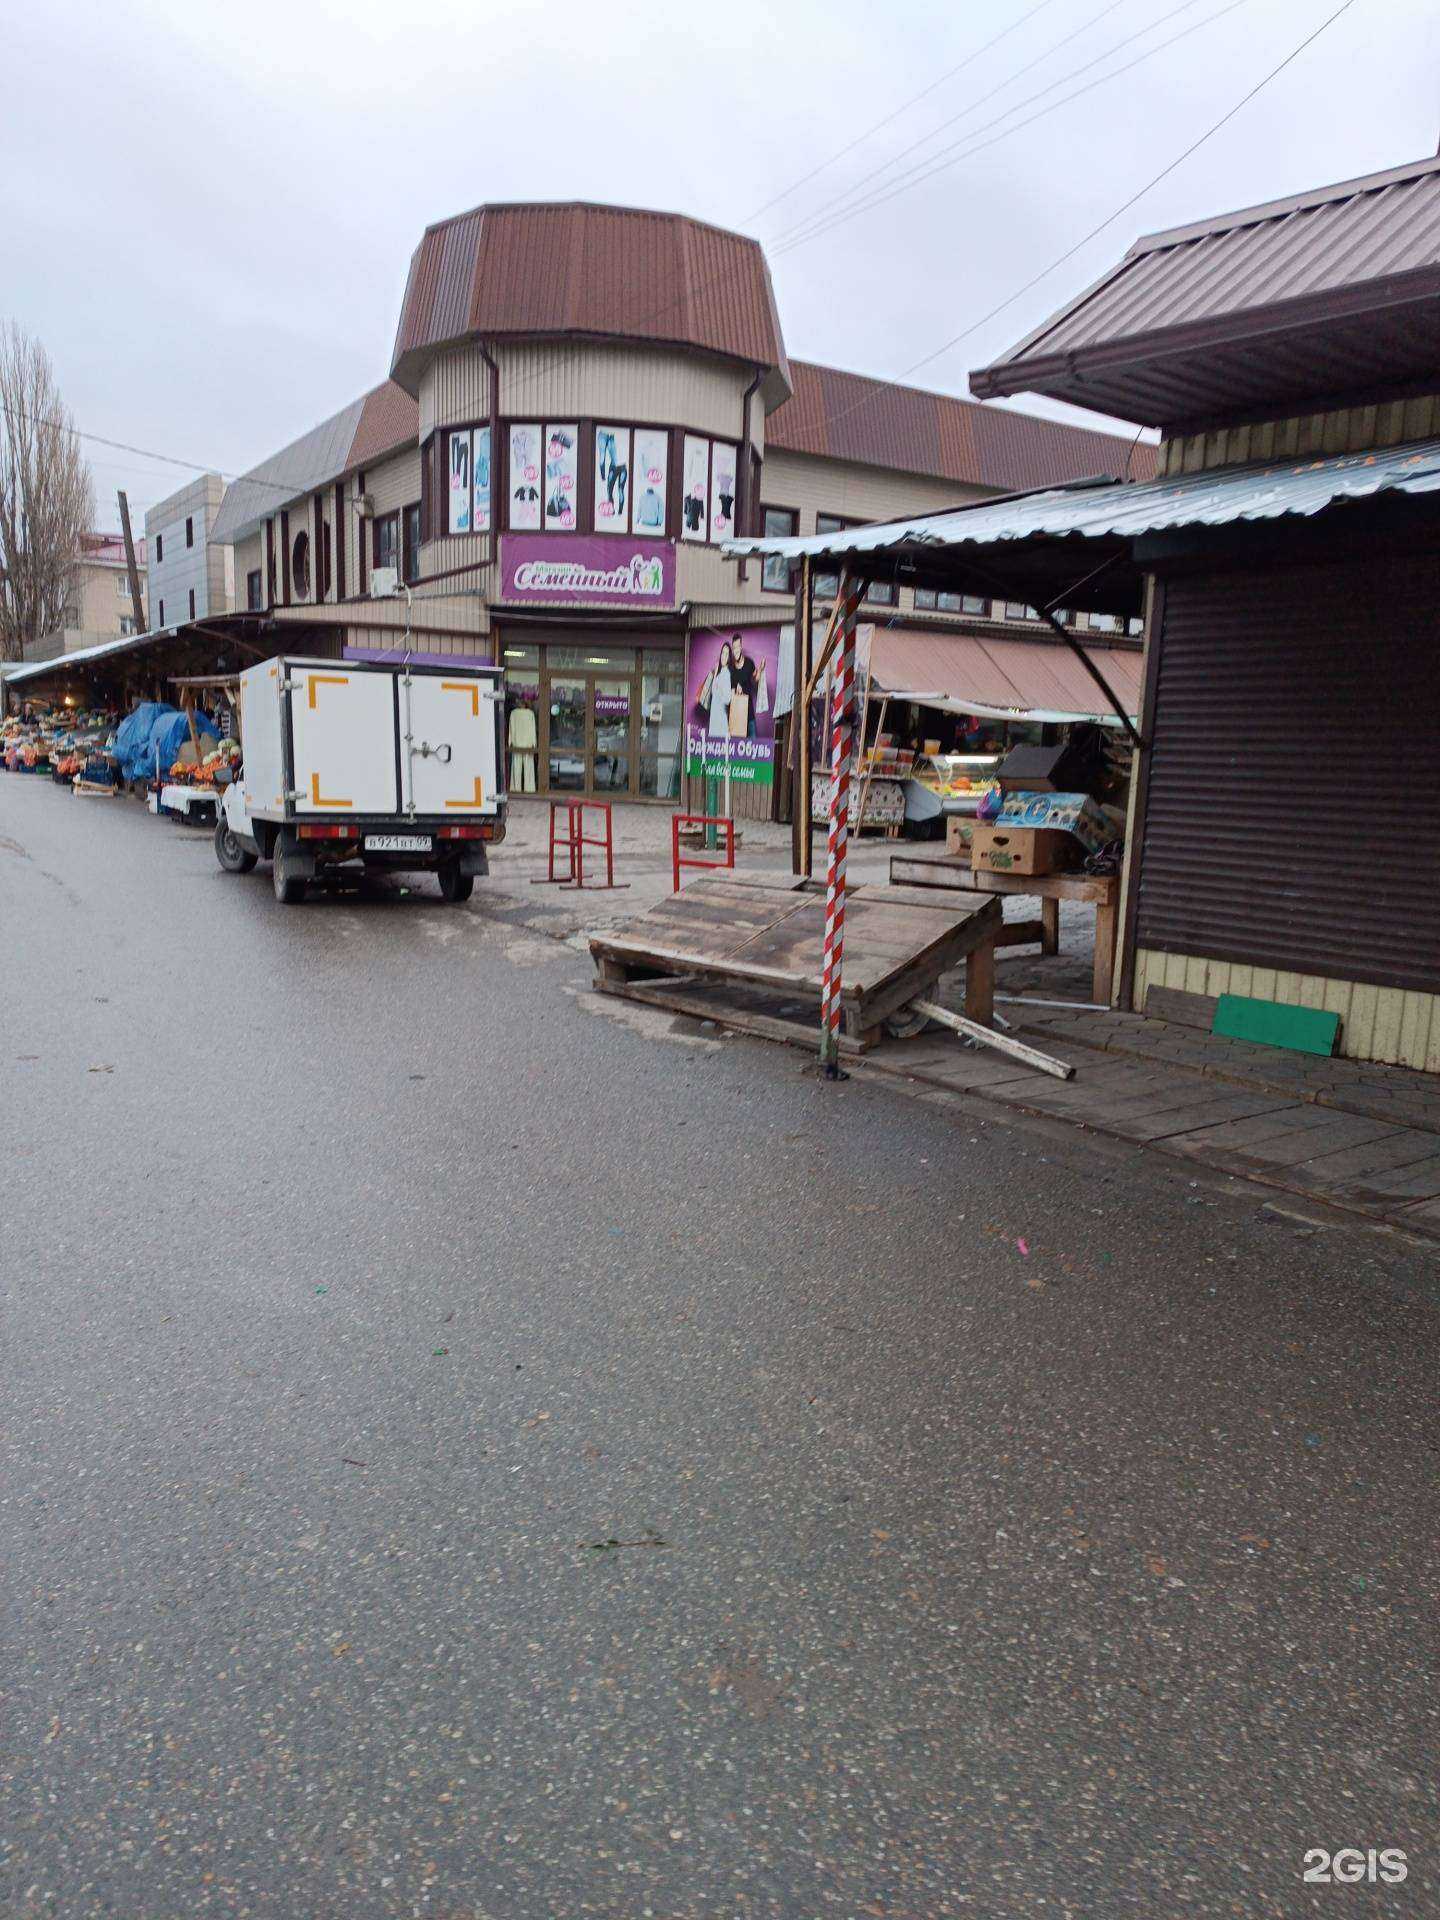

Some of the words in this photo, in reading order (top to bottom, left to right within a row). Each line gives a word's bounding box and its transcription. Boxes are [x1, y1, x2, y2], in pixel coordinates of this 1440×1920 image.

[516, 565, 630, 589] Семейный
[595, 700, 628, 710] ОТКРЫТО
[687, 738, 727, 757] Оджда
[737, 740, 771, 760] Обувь
